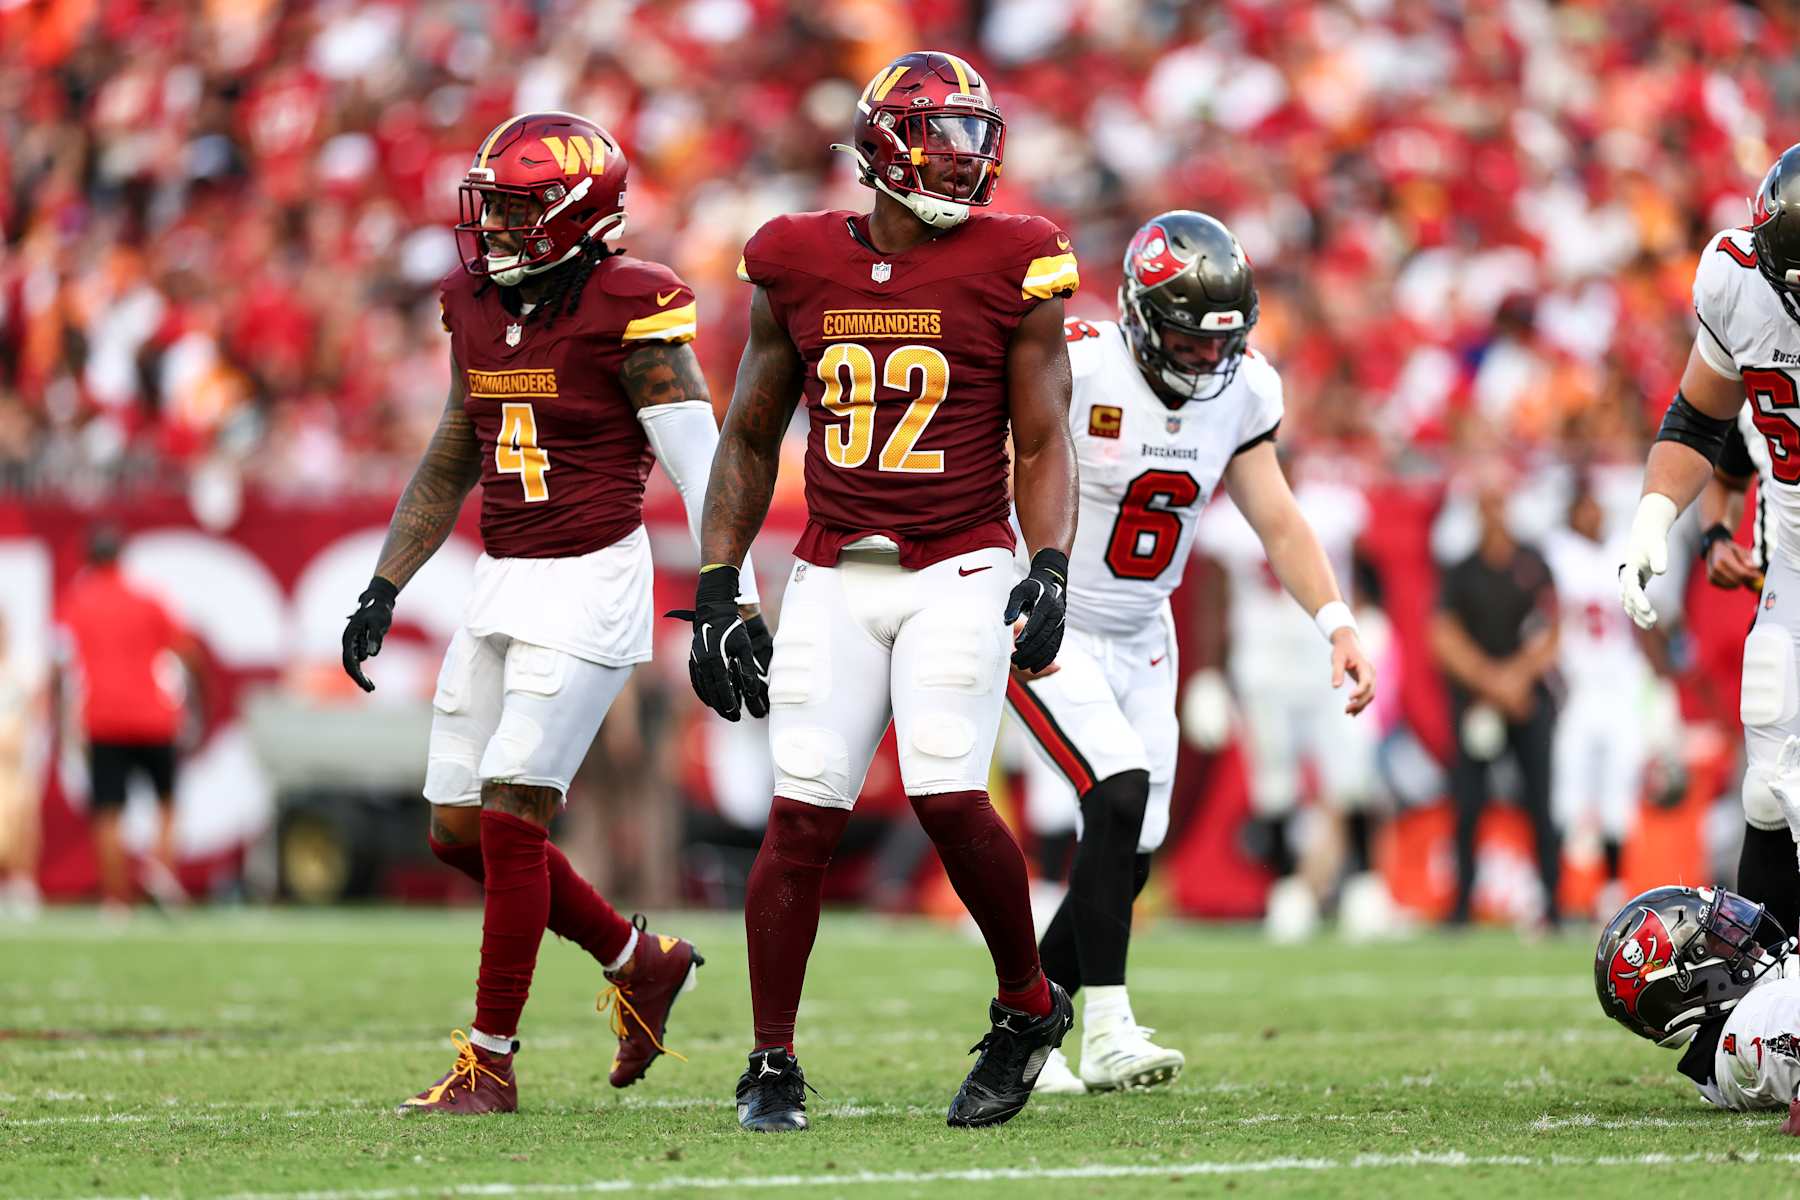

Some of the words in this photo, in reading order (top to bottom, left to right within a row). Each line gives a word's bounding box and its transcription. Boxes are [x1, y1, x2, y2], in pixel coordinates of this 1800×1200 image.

[823, 314, 941, 335] COMMANDERS
[469, 374, 557, 393] COMMANDERS
[817, 342, 950, 473] 92
[496, 402, 550, 503] 4
[1104, 468, 1200, 581] 6
